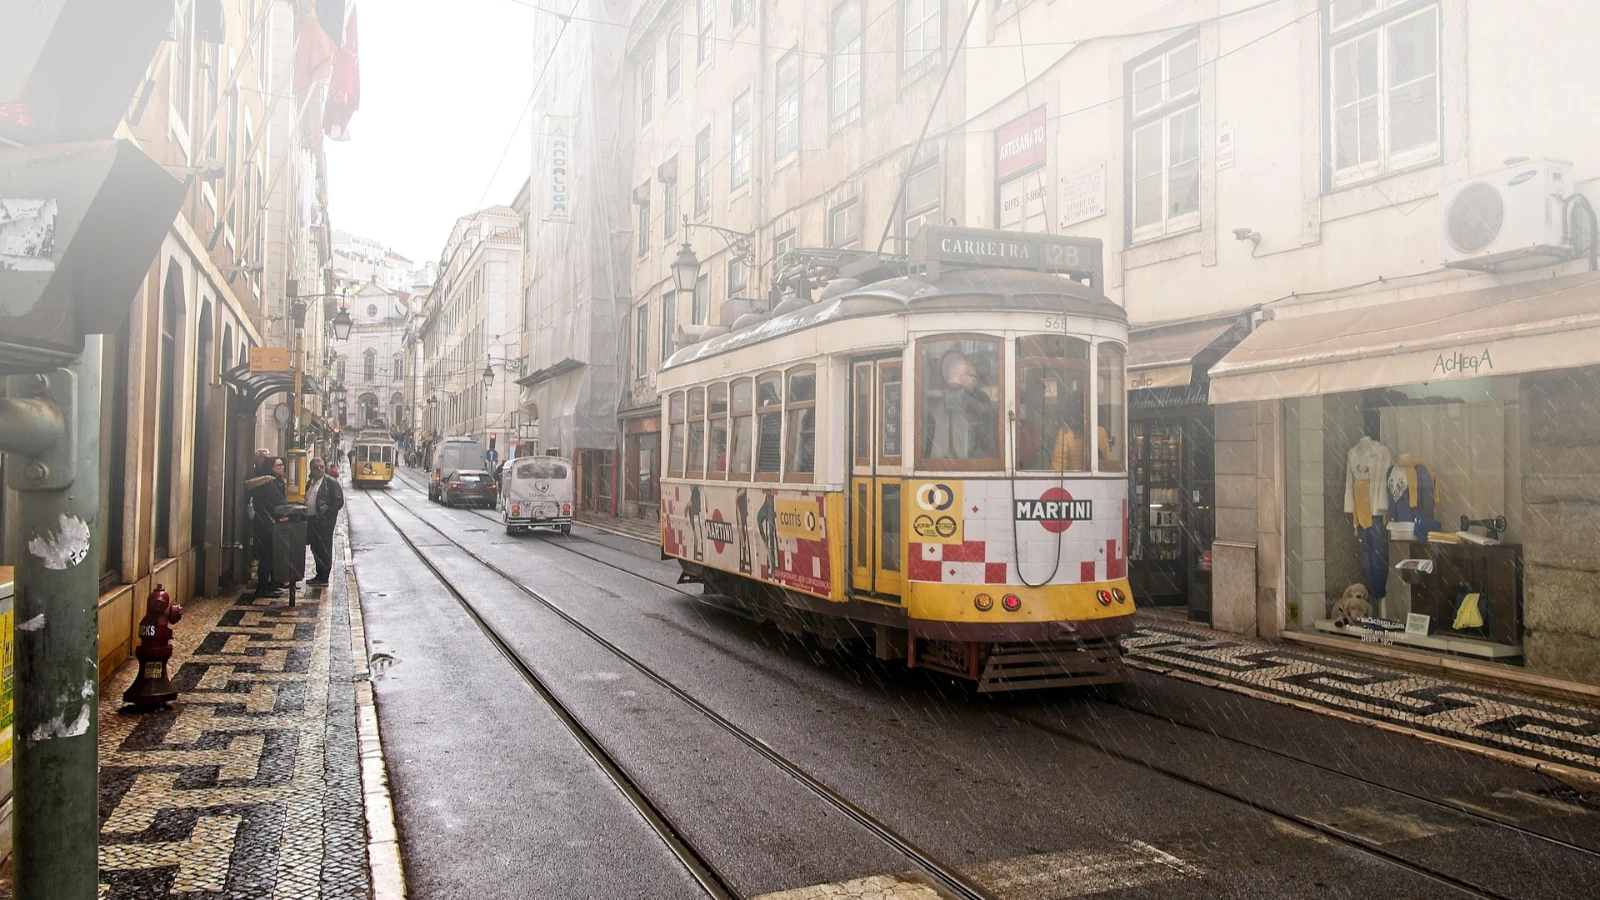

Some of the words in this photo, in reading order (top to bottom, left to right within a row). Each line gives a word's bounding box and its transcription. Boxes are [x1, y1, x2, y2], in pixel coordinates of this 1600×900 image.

[999, 126, 1044, 161] ARTESANATO
[1004, 196, 1020, 212] GIFTS
[941, 238, 1029, 258] CARREIRA
[1051, 244, 1079, 266] 28
[1045, 317, 1066, 330] 568
[1131, 378, 1153, 388] DMC
[780, 508, 801, 527] carris
[1016, 501, 1091, 519] MARTINI
[705, 521, 733, 543] MARTINI
